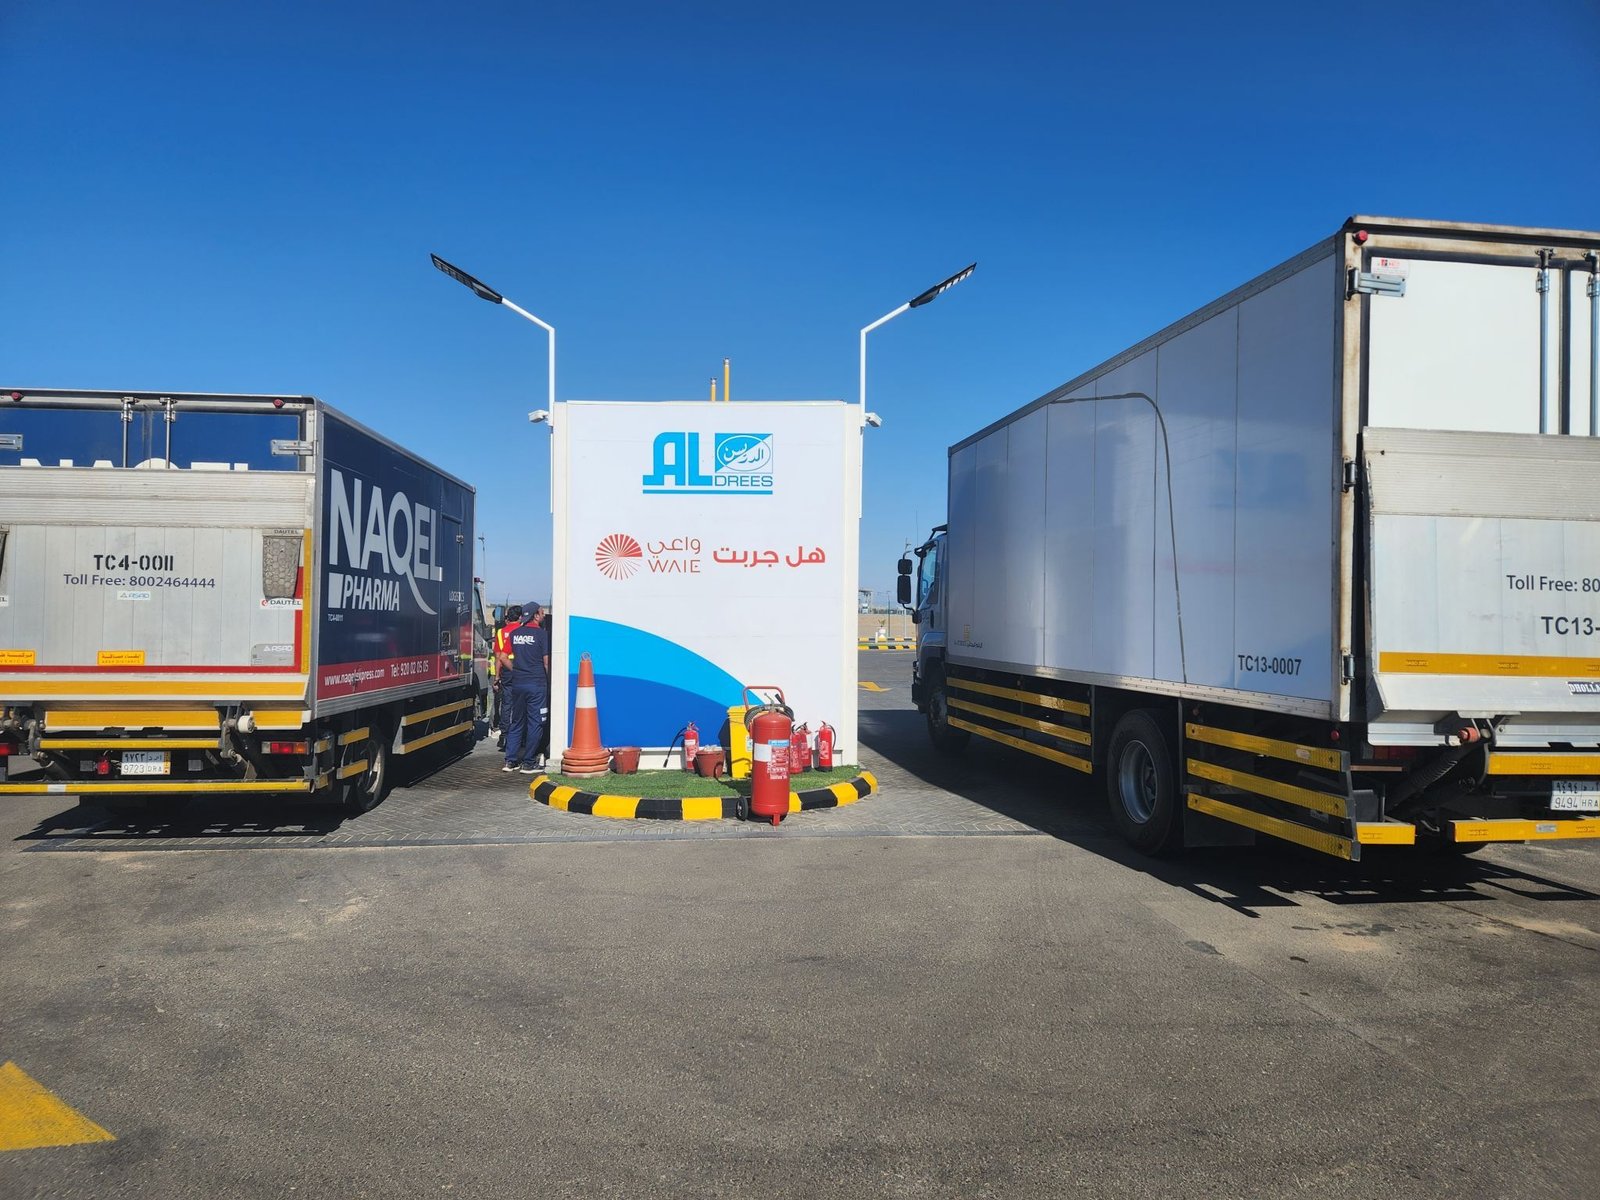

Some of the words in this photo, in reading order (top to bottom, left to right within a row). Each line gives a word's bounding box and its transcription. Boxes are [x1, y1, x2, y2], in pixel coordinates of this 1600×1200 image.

[643, 432, 713, 486] AL
[714, 475, 773, 486] DREES
[329, 468, 443, 615] NAQEL
[647, 536, 701, 559] واعي
[647, 559, 701, 573] WAIE
[712, 546, 779, 568] جربت
[785, 546, 826, 568] هل
[63, 573, 88, 586] Toll
[92, 575, 126, 587] Free:
[129, 575, 216, 588] 8002464444
[1506, 574, 1534, 590] Toll
[1539, 576, 1578, 592] Free:
[343, 574, 400, 611] PHARMA
[513, 635, 535, 646] NAQEL
[1238, 655, 1302, 676] TC13-0007
[123, 764, 145, 774] 9723
[1554, 797, 1578, 808] 9494
[1582, 799, 1599, 807] HRA
